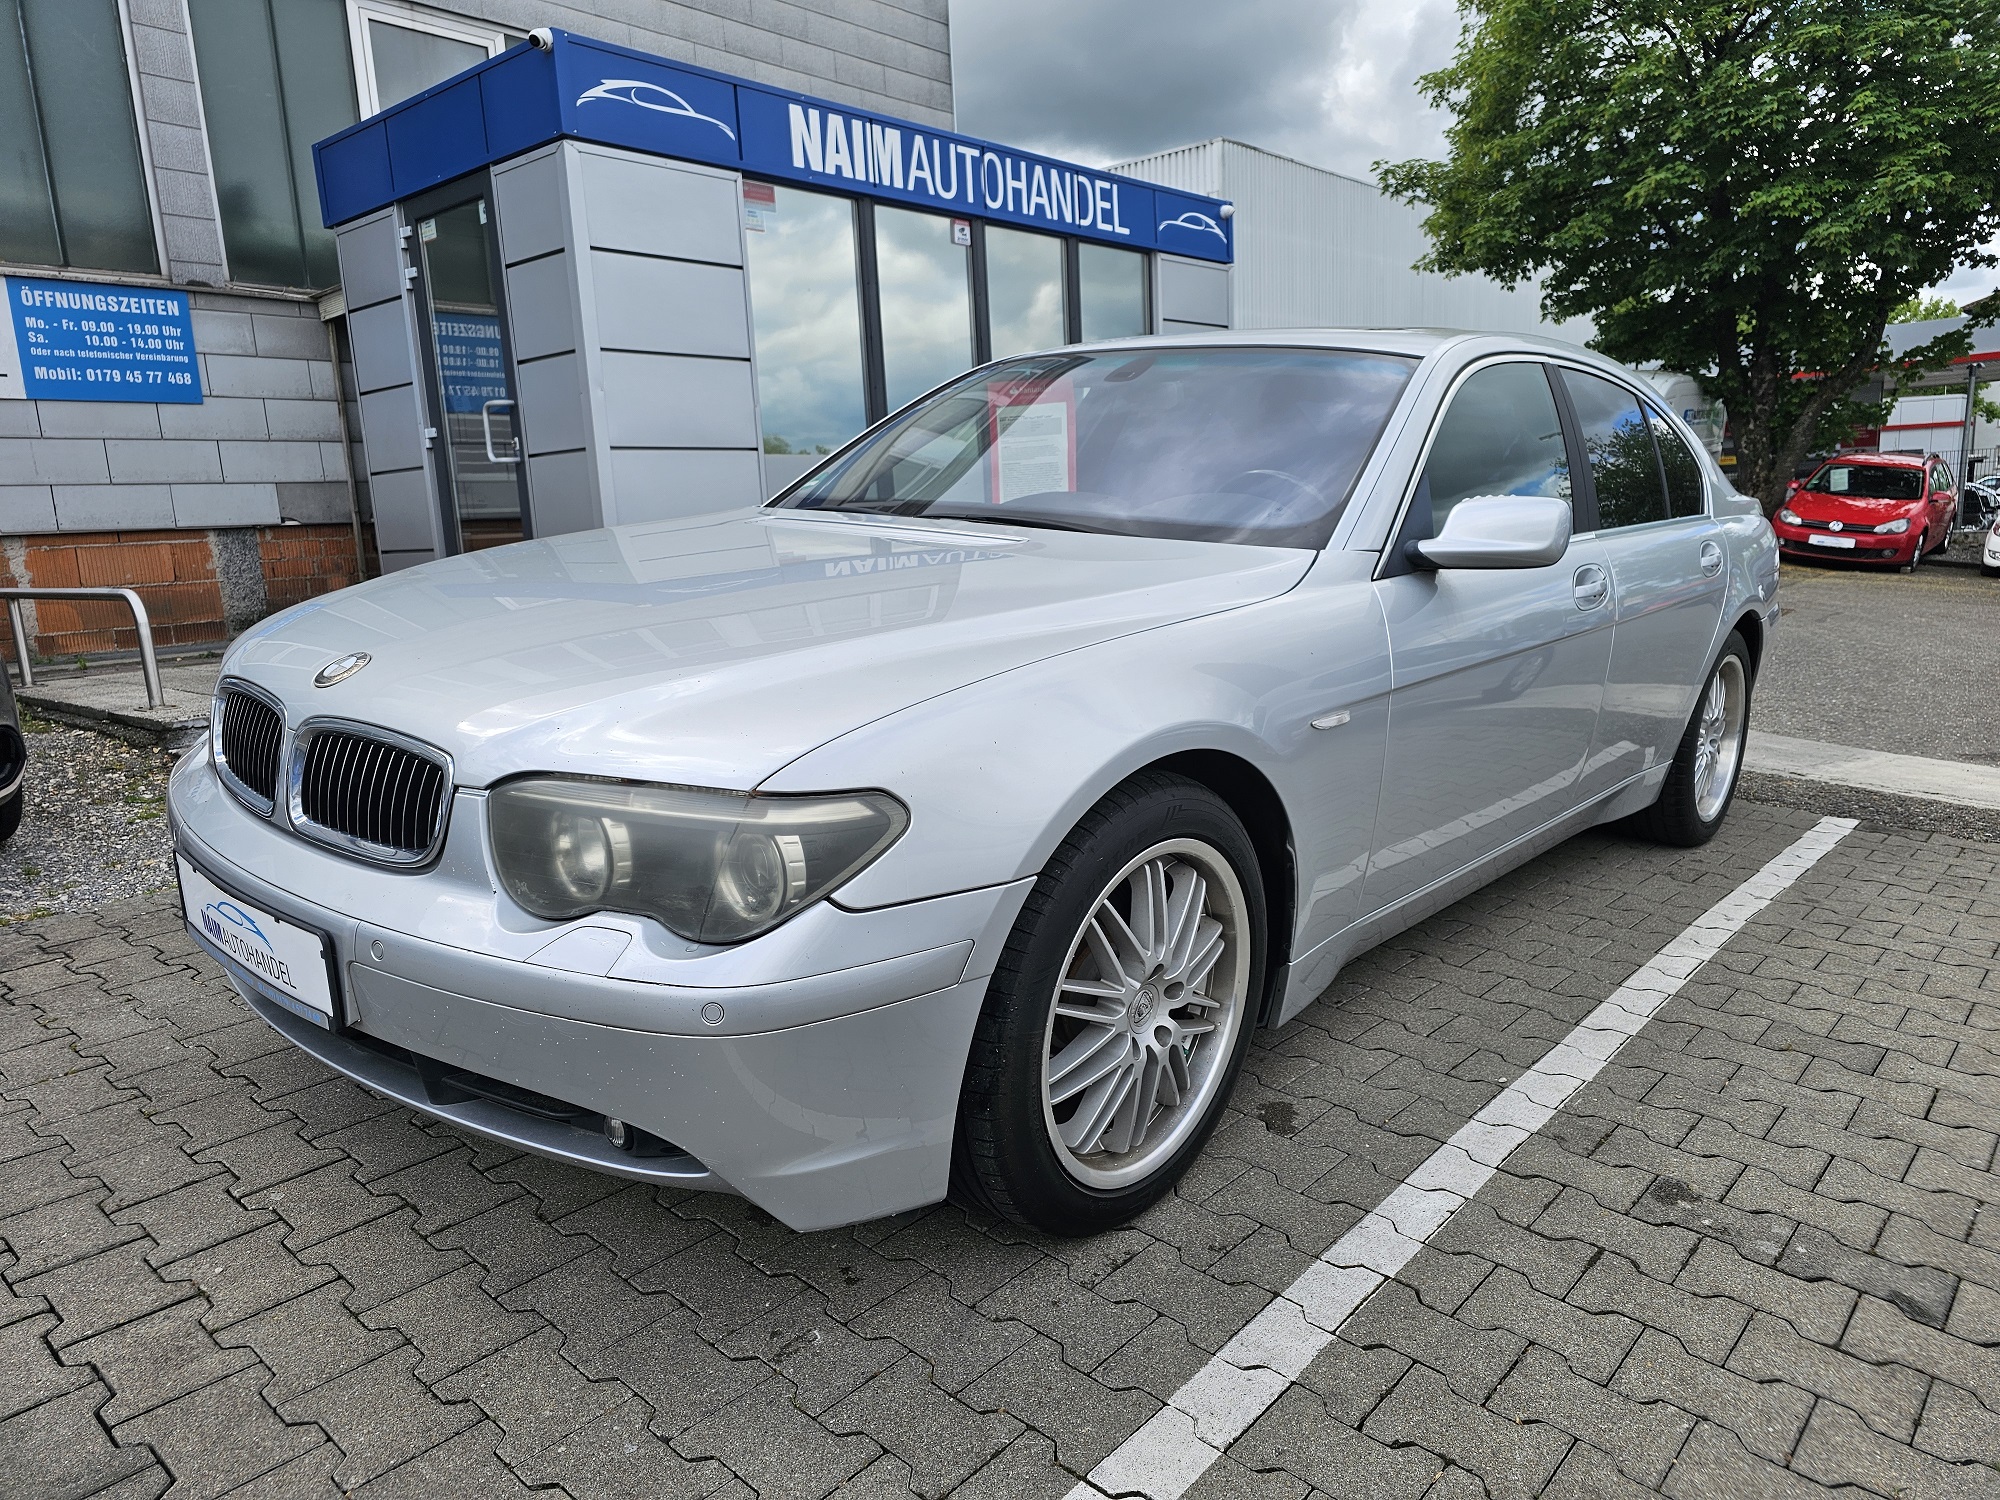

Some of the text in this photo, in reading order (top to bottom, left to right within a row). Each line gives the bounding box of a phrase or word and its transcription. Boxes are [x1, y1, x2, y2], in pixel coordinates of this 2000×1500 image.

[21, 286, 180, 316] ÖFFNUNGSZEITEN
[25, 316, 49, 329] Mo.
[62, 318, 78, 331] Fr.
[81, 320, 115, 333] 09.00
[127, 323, 159, 336] 19.00
[162, 325, 181, 337] Uhr
[28, 331, 49, 343] Sa.
[85, 334, 118, 347] 10.00
[130, 337, 162, 350] 14.00
[165, 339, 184, 350] Uhr
[31, 347, 189, 363] Oder nach telefonischer Vereinbarung
[34, 366, 192, 385] Mobil: 0179 45 77 468
[222, 926, 298, 991] AUTOHANDEL
